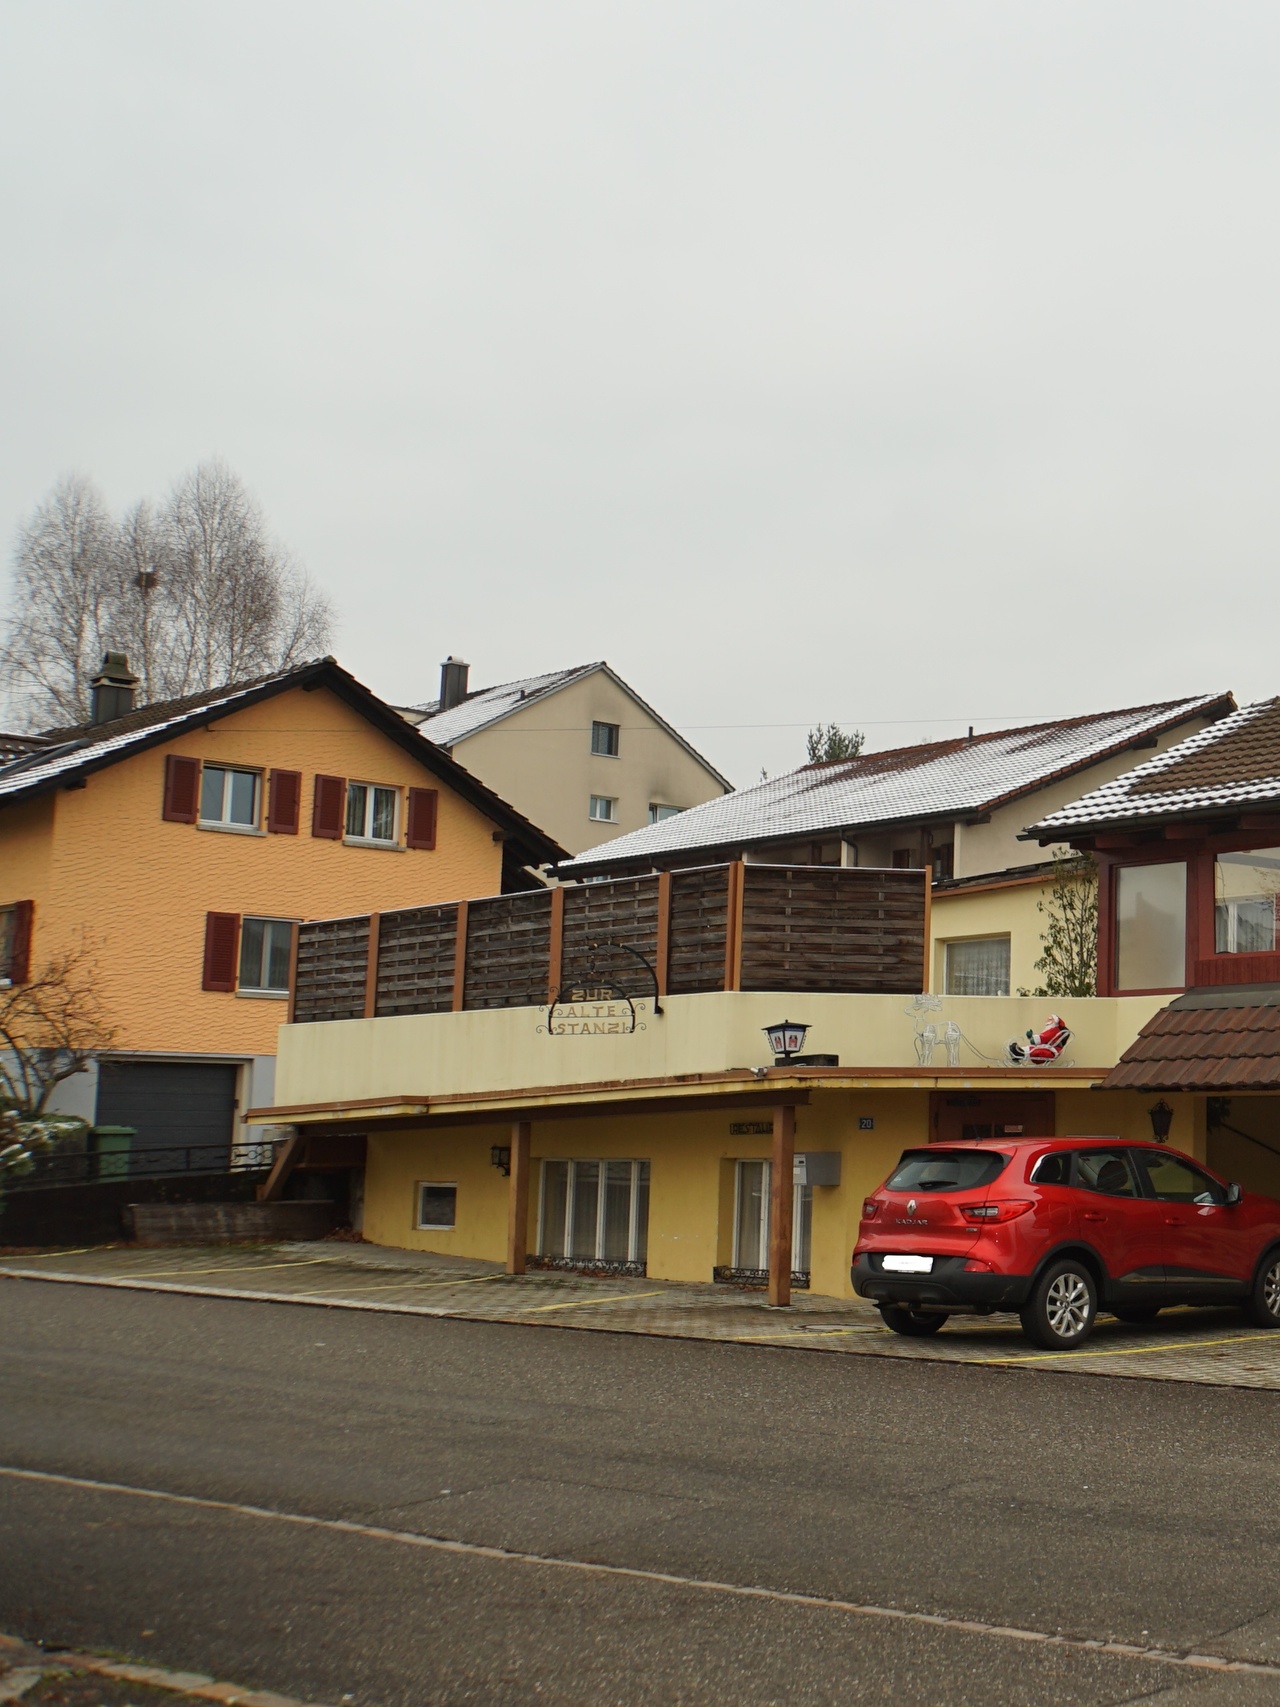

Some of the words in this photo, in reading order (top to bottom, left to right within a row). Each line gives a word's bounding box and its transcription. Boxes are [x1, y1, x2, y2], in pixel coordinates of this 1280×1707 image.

[571, 988, 613, 1001] ZUR
[567, 1005, 616, 1018] ALTE
[556, 1022, 626, 1035] STANZI
[861, 1119, 872, 1129] 20
[895, 1218, 929, 1226] KADJAR
